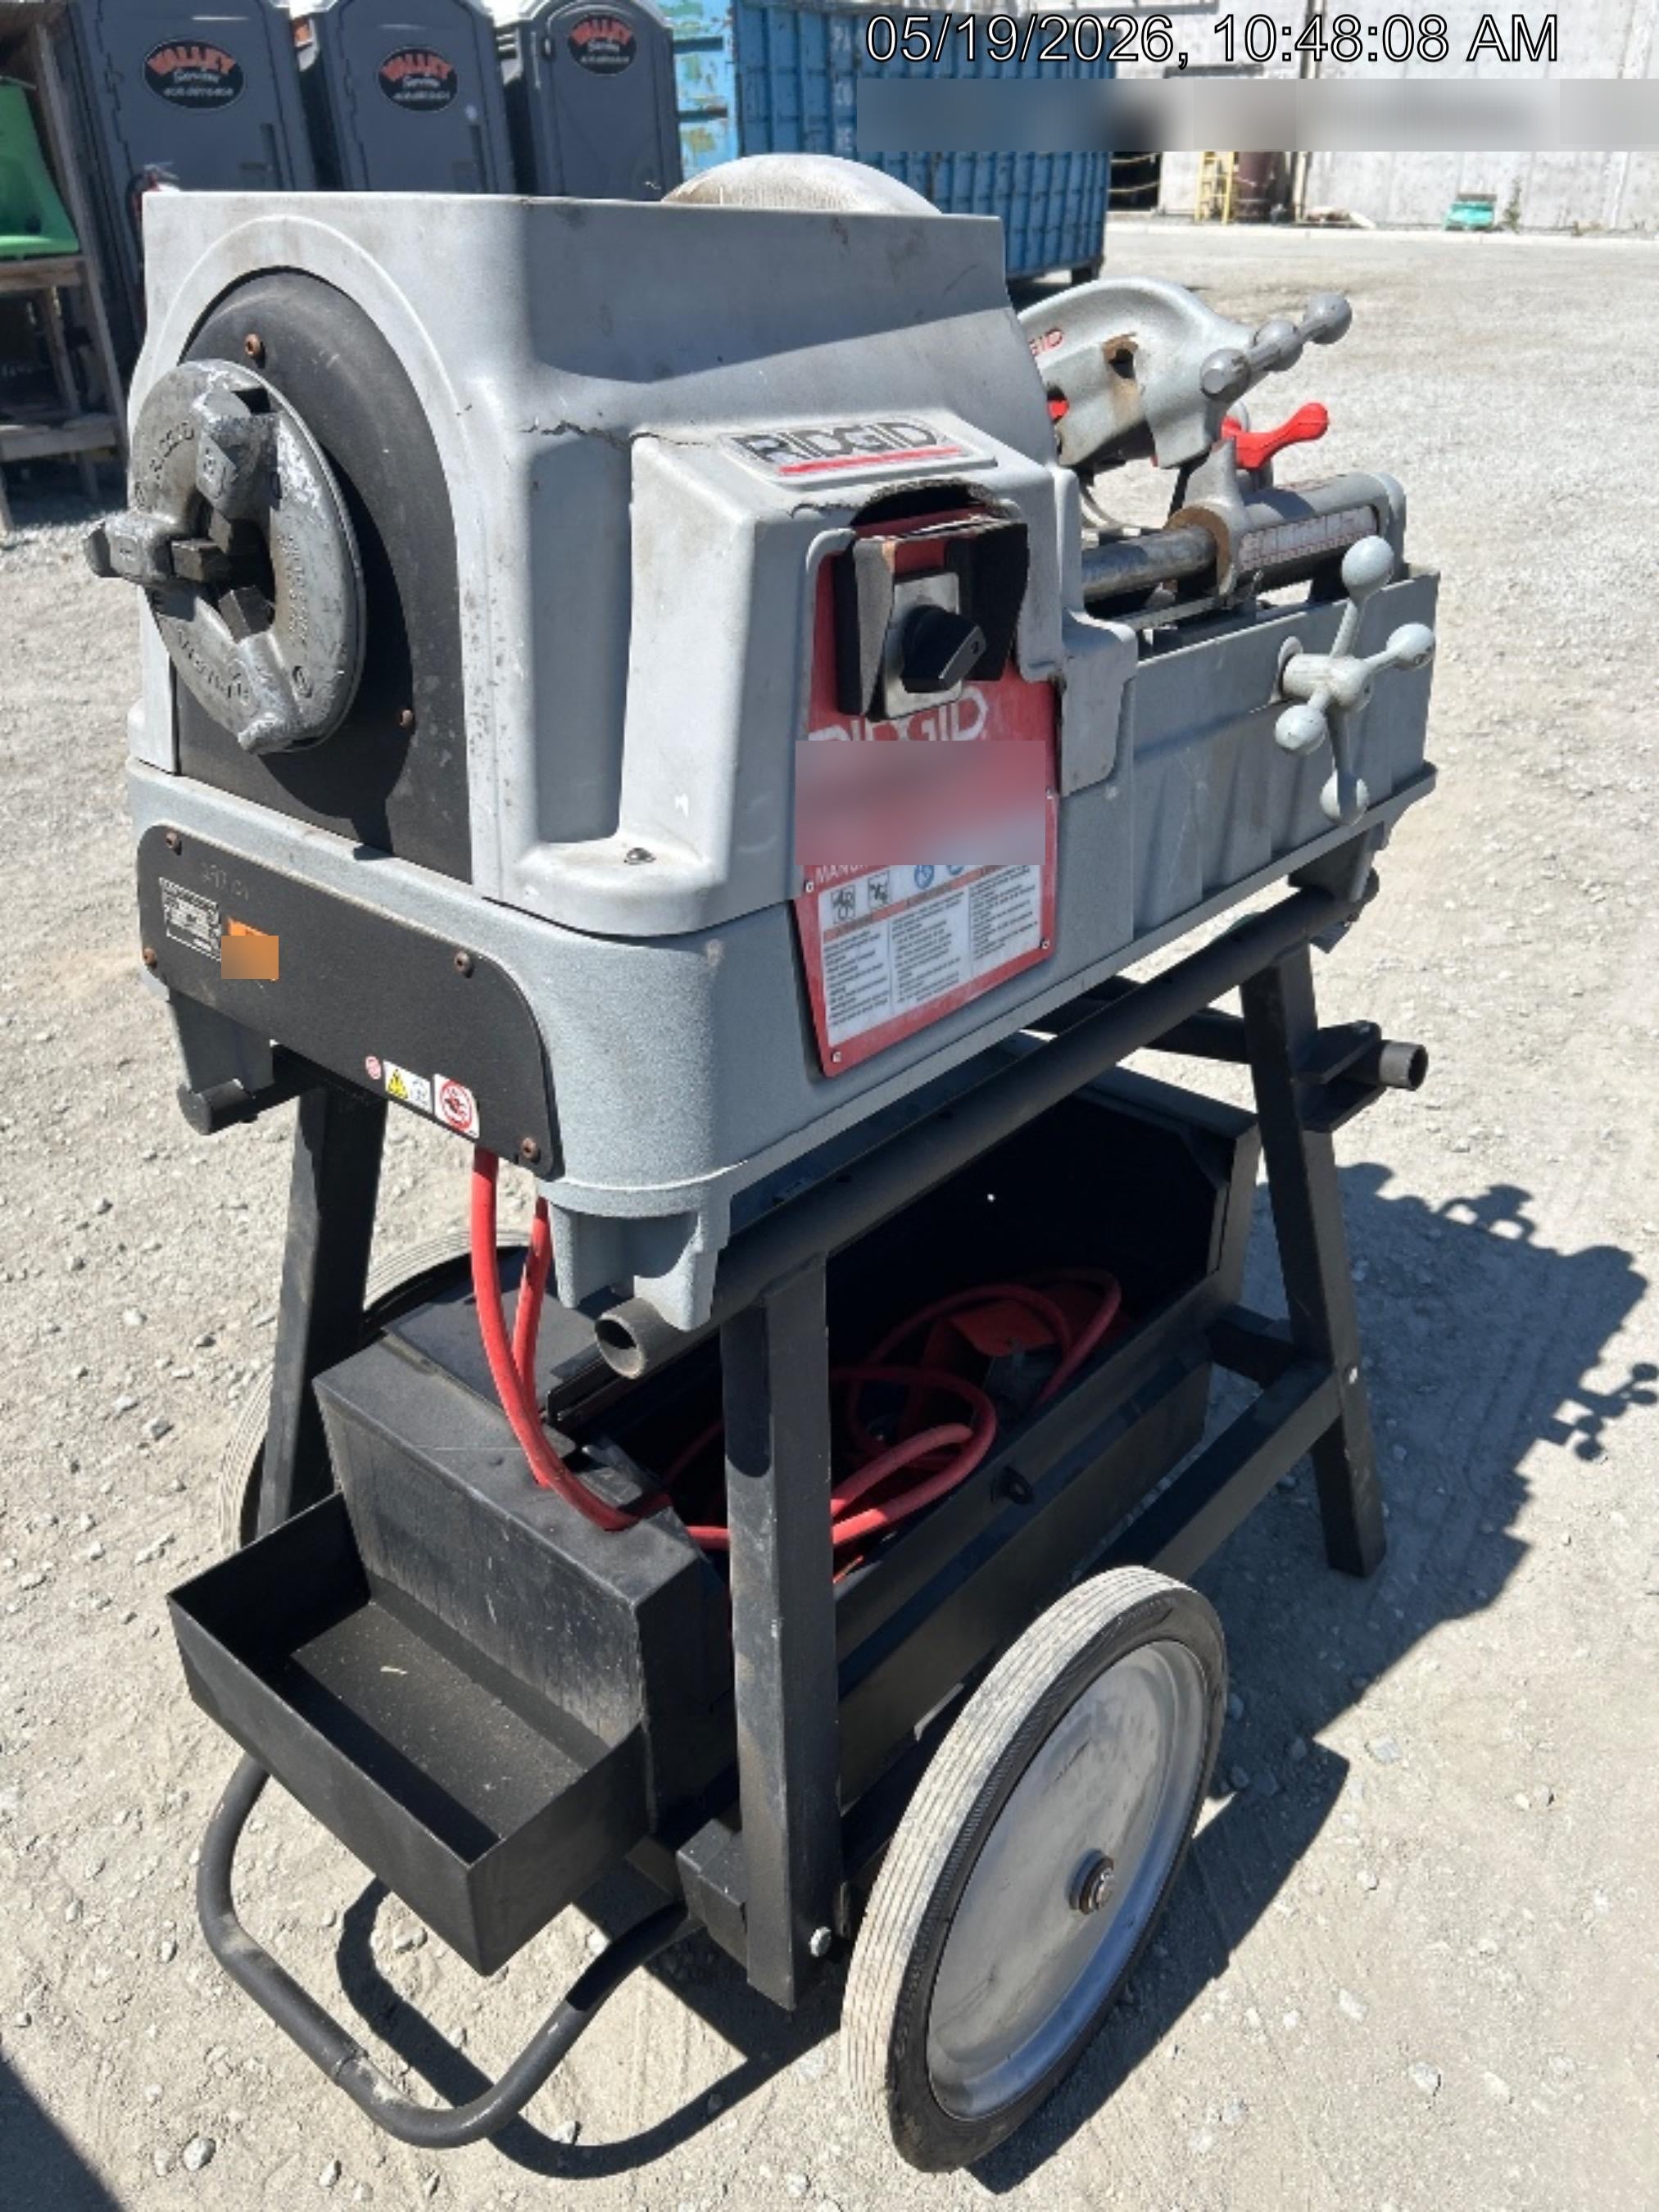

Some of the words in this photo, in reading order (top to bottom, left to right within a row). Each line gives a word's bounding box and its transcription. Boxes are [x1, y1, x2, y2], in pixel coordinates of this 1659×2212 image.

[571, 19, 632, 46] VALLEY
[147, 46, 236, 75] VALLEY
[383, 52, 454, 81] VALLEY
[732, 421, 937, 462] RIDGID
